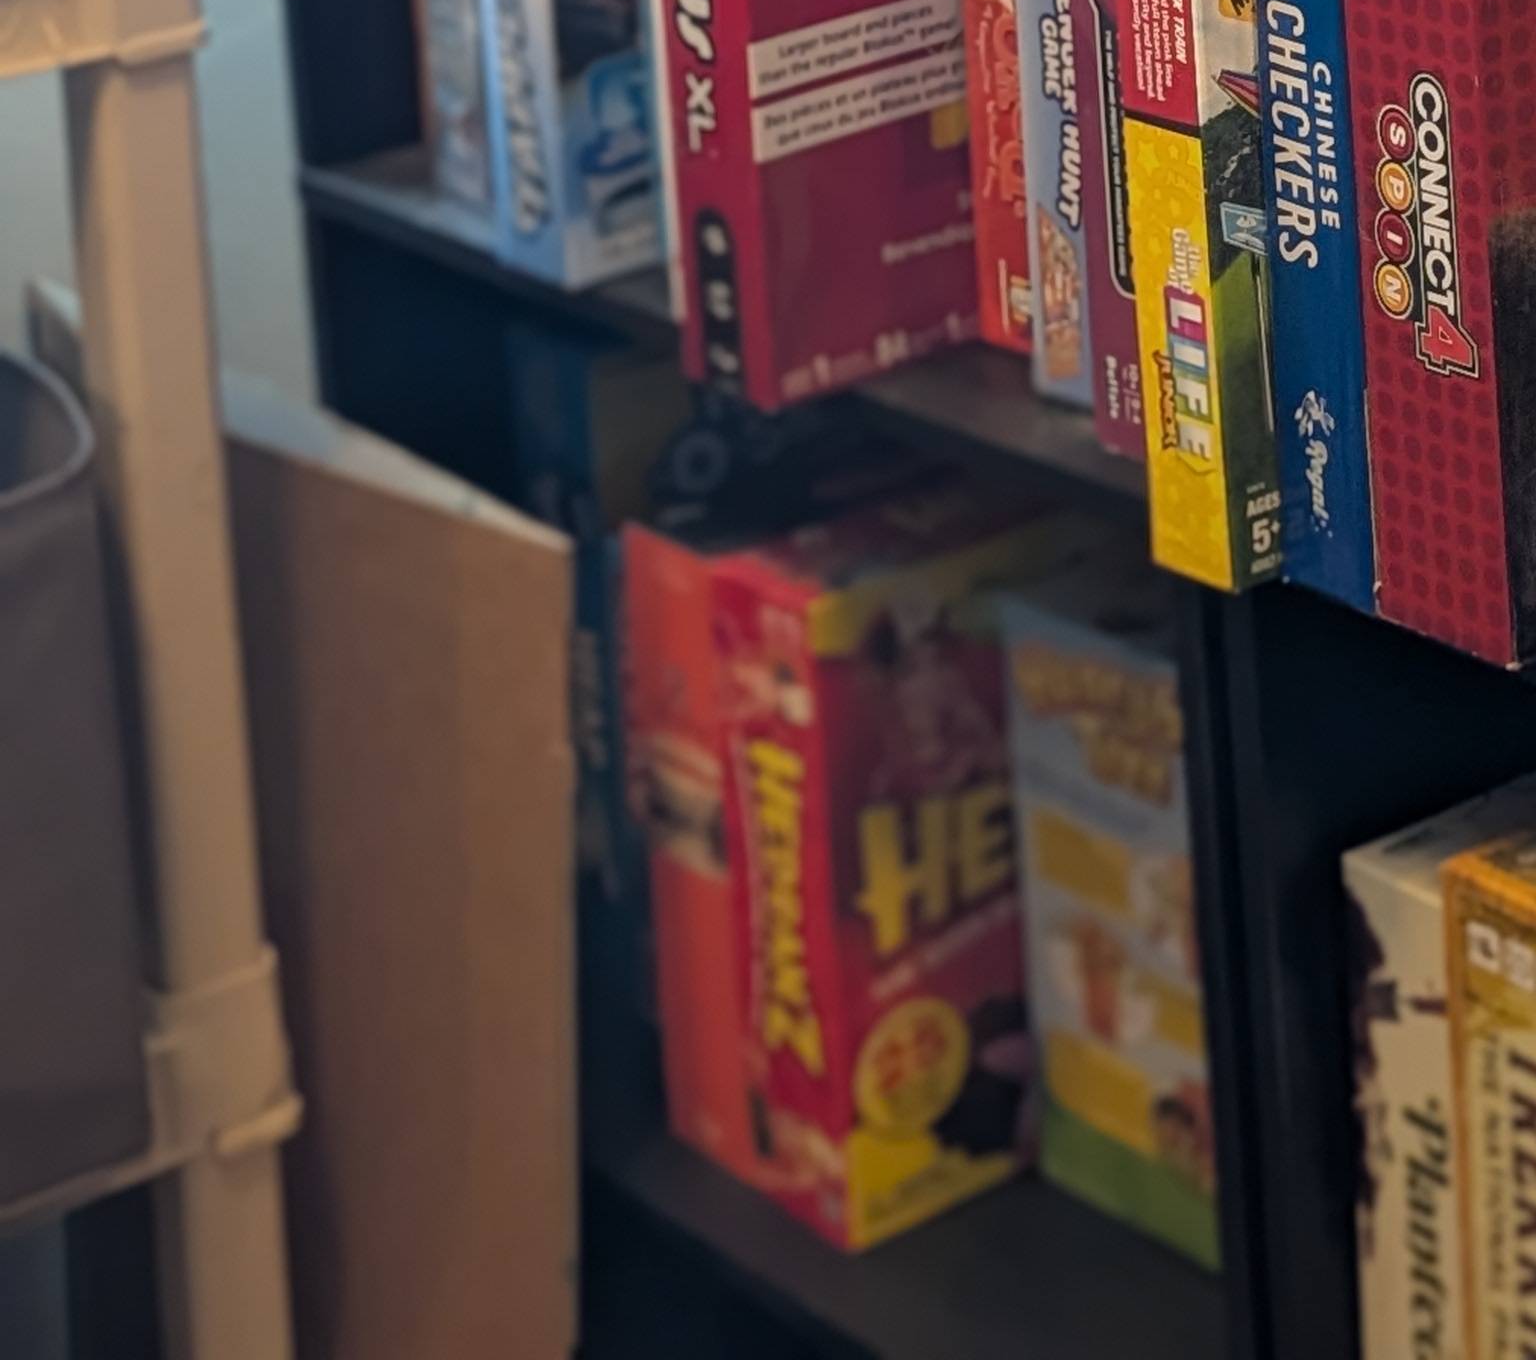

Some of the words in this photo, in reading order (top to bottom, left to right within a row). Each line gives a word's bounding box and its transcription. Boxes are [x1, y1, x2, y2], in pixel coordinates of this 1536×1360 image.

[1041, 13, 1062, 100] GAME
[1160, 32, 1172, 61] pink
[1173, 15, 1188, 64] TRAIN
[685, 74, 716, 153] XL
[1312, 61, 1342, 231] CHINESE
[1055, 125, 1082, 232] HUNT
[1376, 116, 1414, 312] SPIN
[1413, 80, 1456, 317] CONNECT
[1173, 227, 1195, 294] Game
[1187, 246, 1202, 274] the
[1168, 296, 1213, 461] LIFE
[1416, 317, 1479, 379] 4
[1105, 354, 1120, 420] Buffalo
[1153, 350, 1179, 451] JUNIOR
[1245, 495, 1281, 519] AGES
[1250, 519, 1281, 555] 5+
